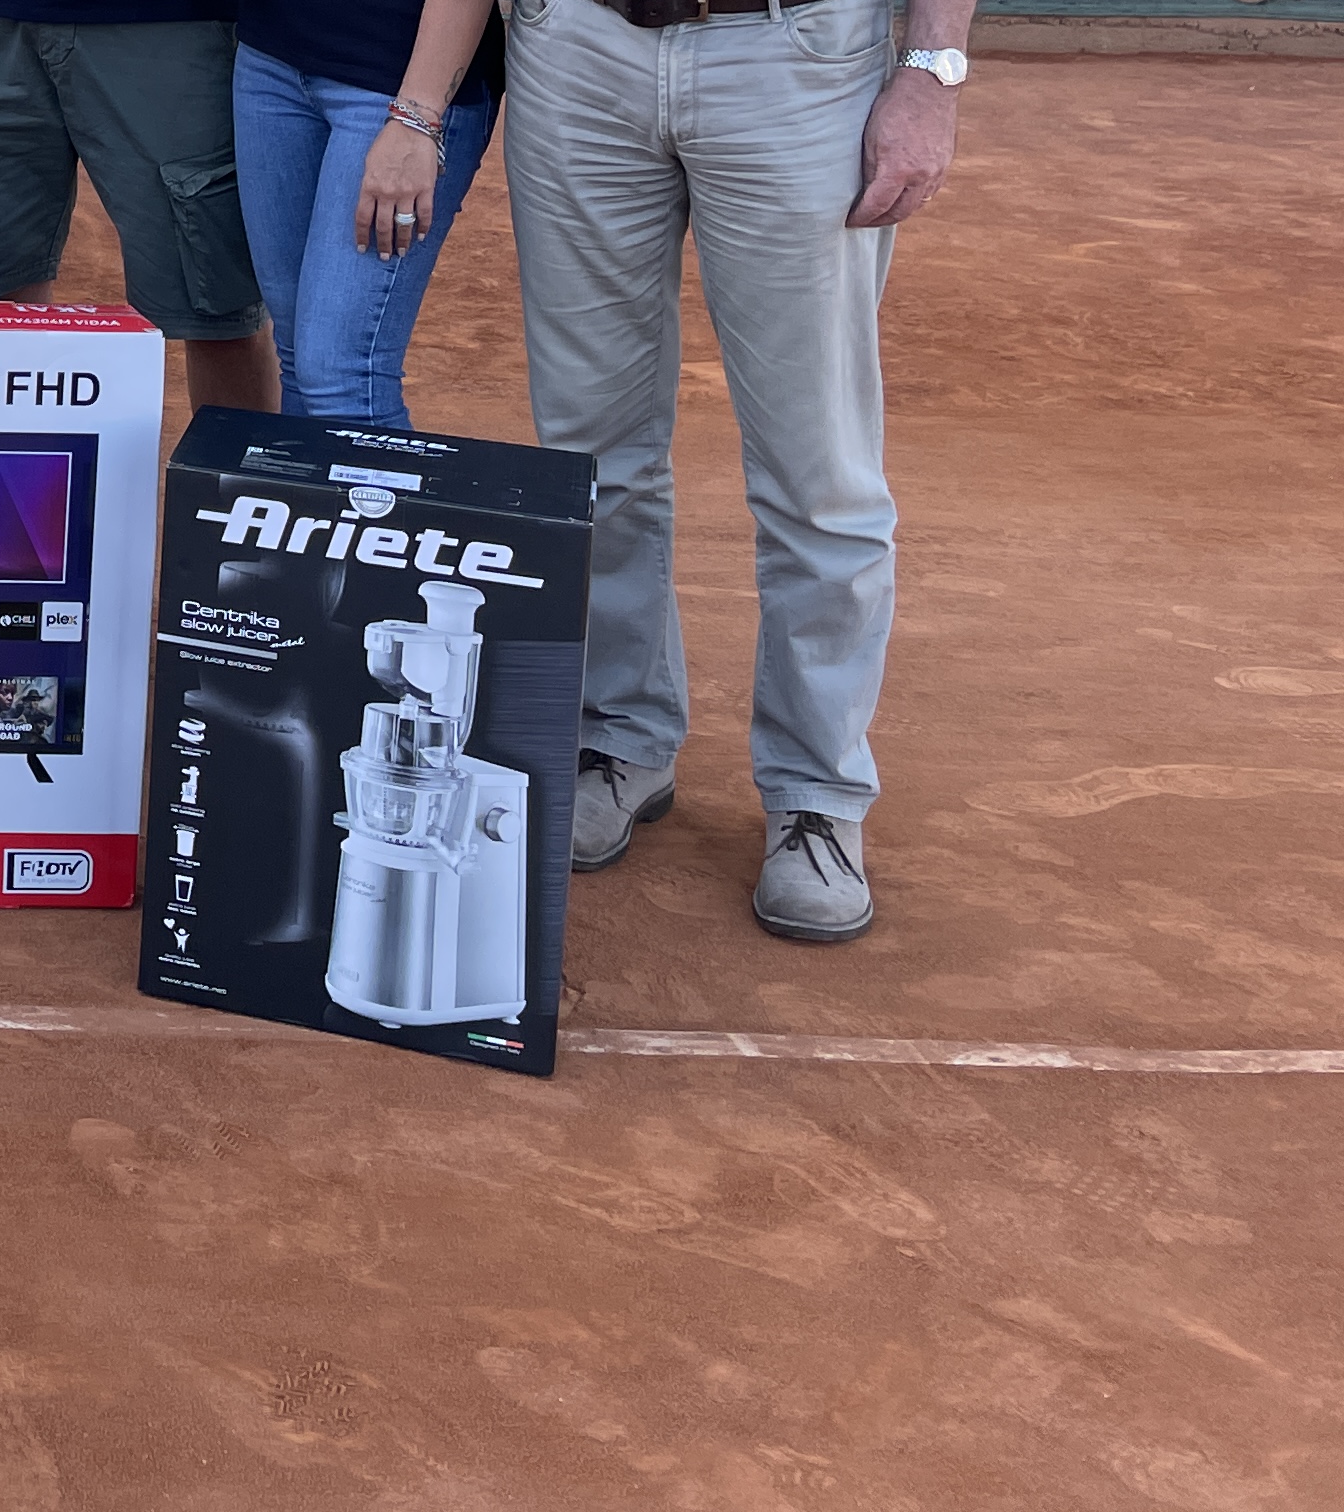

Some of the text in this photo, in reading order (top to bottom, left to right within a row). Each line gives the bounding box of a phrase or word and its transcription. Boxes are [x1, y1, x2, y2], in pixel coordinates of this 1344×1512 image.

[6, 371, 100, 406] FHD
[195, 496, 544, 589] Ariete
[47, 613, 77, 627] plex
[182, 600, 280, 629] Centrika
[180, 617, 225, 634] slow
[226, 623, 280, 642] juicer
[227, 659, 273, 672] extractor
